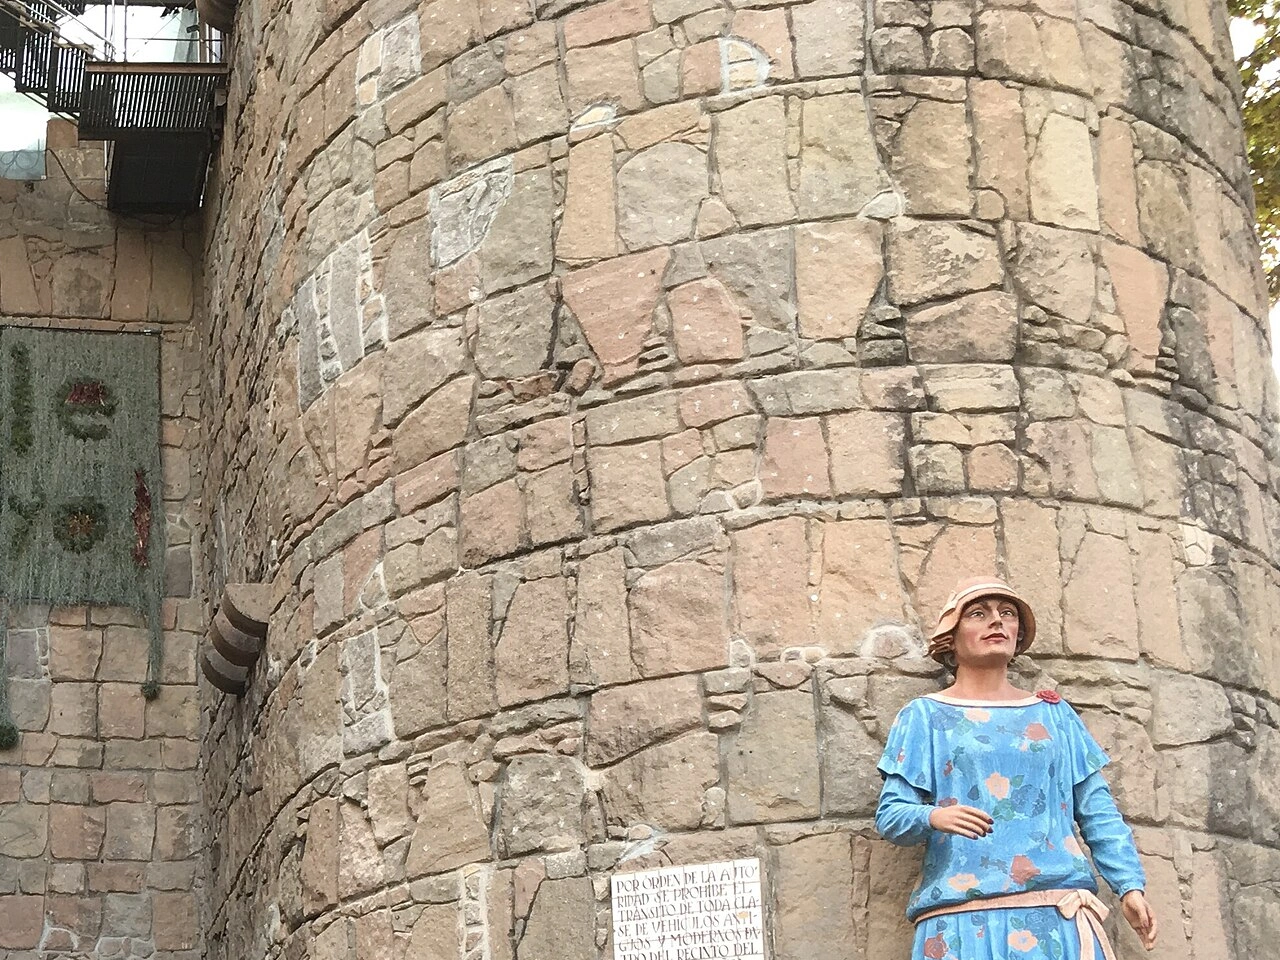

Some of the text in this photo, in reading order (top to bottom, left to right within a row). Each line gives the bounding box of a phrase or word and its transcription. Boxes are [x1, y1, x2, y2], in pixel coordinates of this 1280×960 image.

[617, 879, 640, 893] POR
[685, 870, 698, 884] DE
[701, 870, 715, 883] LA
[617, 882, 752, 908] RIDAD SE PROHIBE EL
[680, 902, 693, 914] DE
[698, 898, 730, 912] TODA
[619, 923, 631, 937] SE
[636, 921, 649, 936] DE
[658, 935, 665, 947] Y
[670, 929, 742, 947] MODERNOS
[734, 942, 758, 957] DEL
